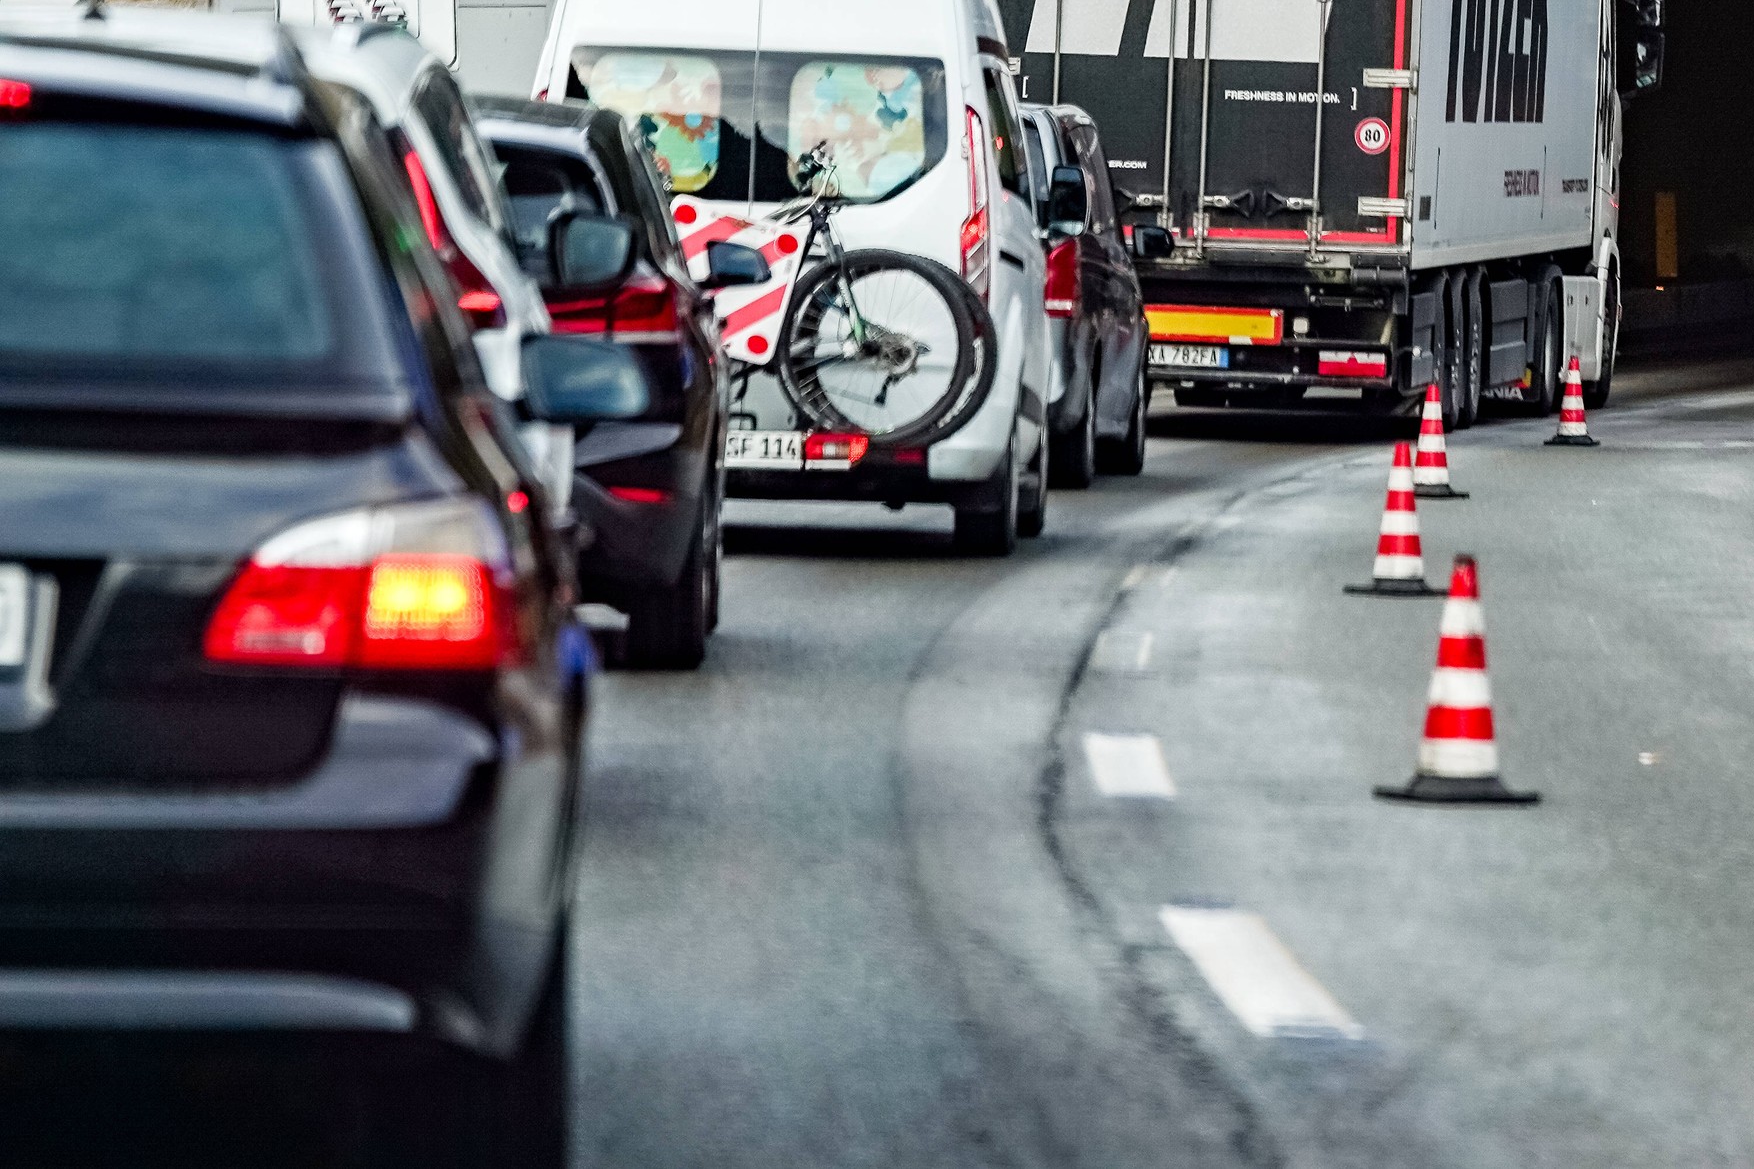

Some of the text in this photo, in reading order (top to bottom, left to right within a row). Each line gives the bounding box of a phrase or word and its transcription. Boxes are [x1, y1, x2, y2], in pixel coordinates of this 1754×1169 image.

[1224, 89, 1341, 104] FRESHNESS IN MOTON.
[1364, 128, 1381, 143] 80
